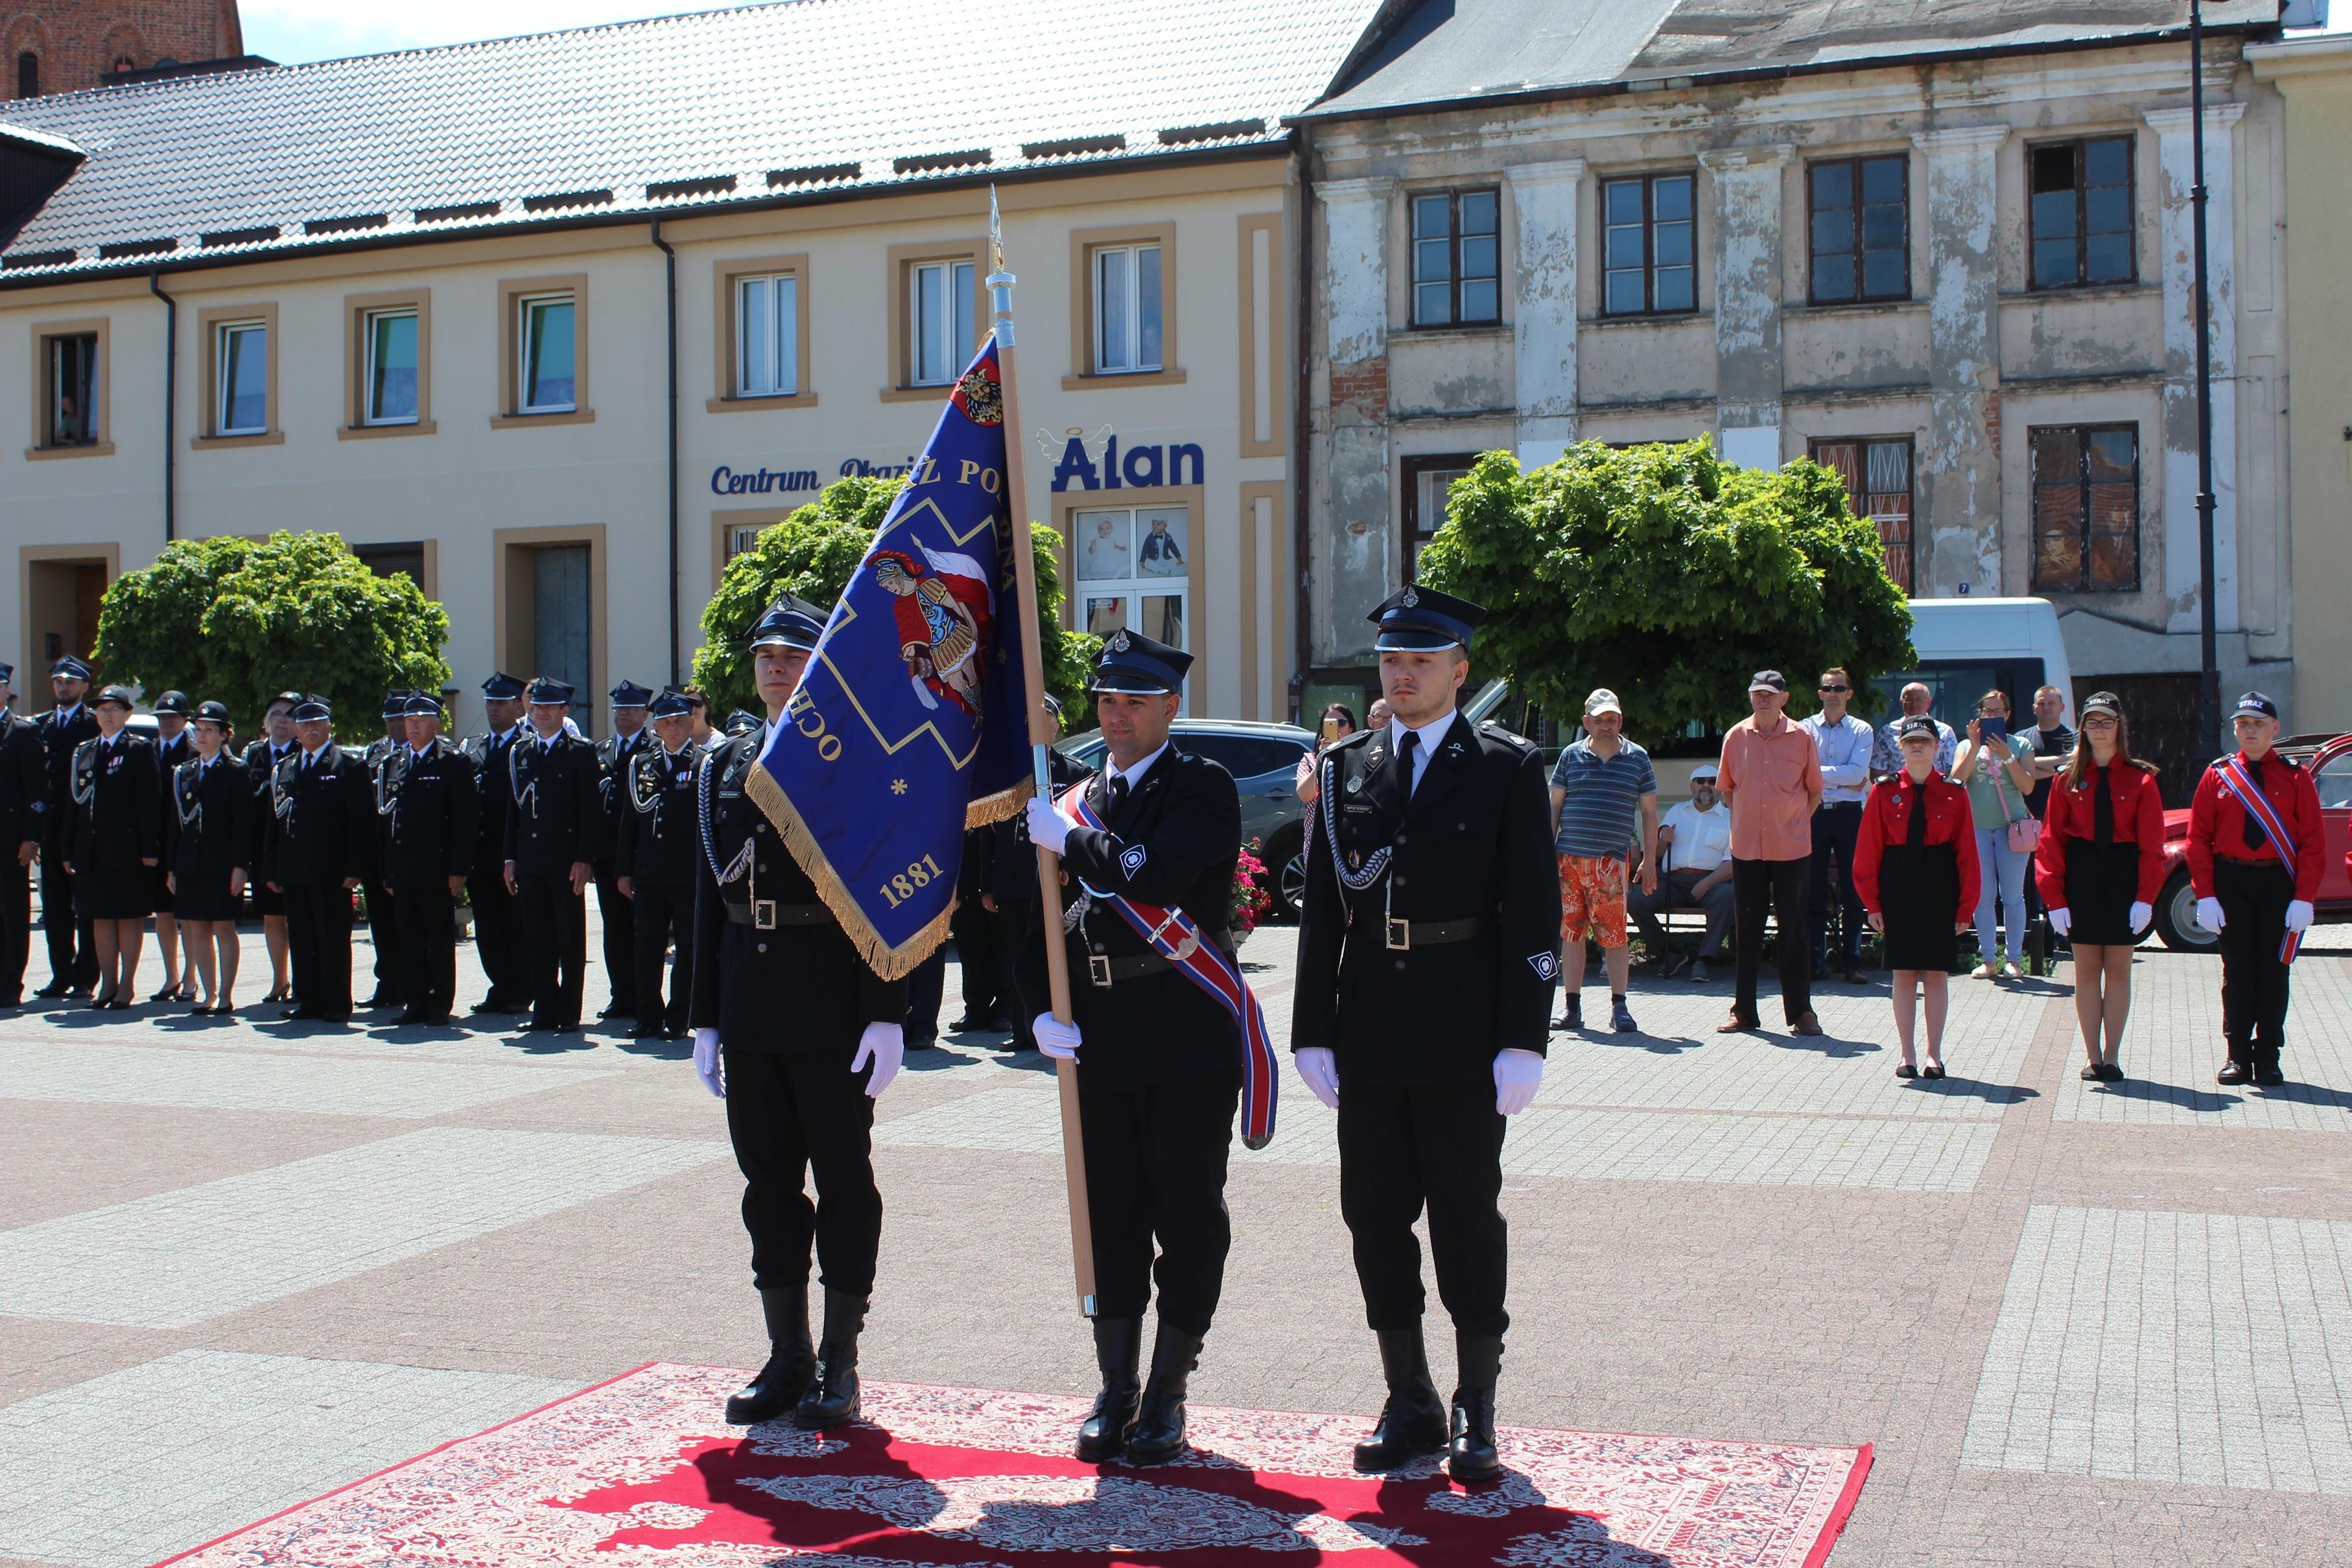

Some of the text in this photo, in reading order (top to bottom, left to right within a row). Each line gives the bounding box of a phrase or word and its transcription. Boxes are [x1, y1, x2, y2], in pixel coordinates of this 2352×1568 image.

[711, 465, 821, 495] Centrum
[1050, 435, 1205, 493] Alan
[1961, 584, 1967, 592] 7
[879, 853, 945, 909] 1881
